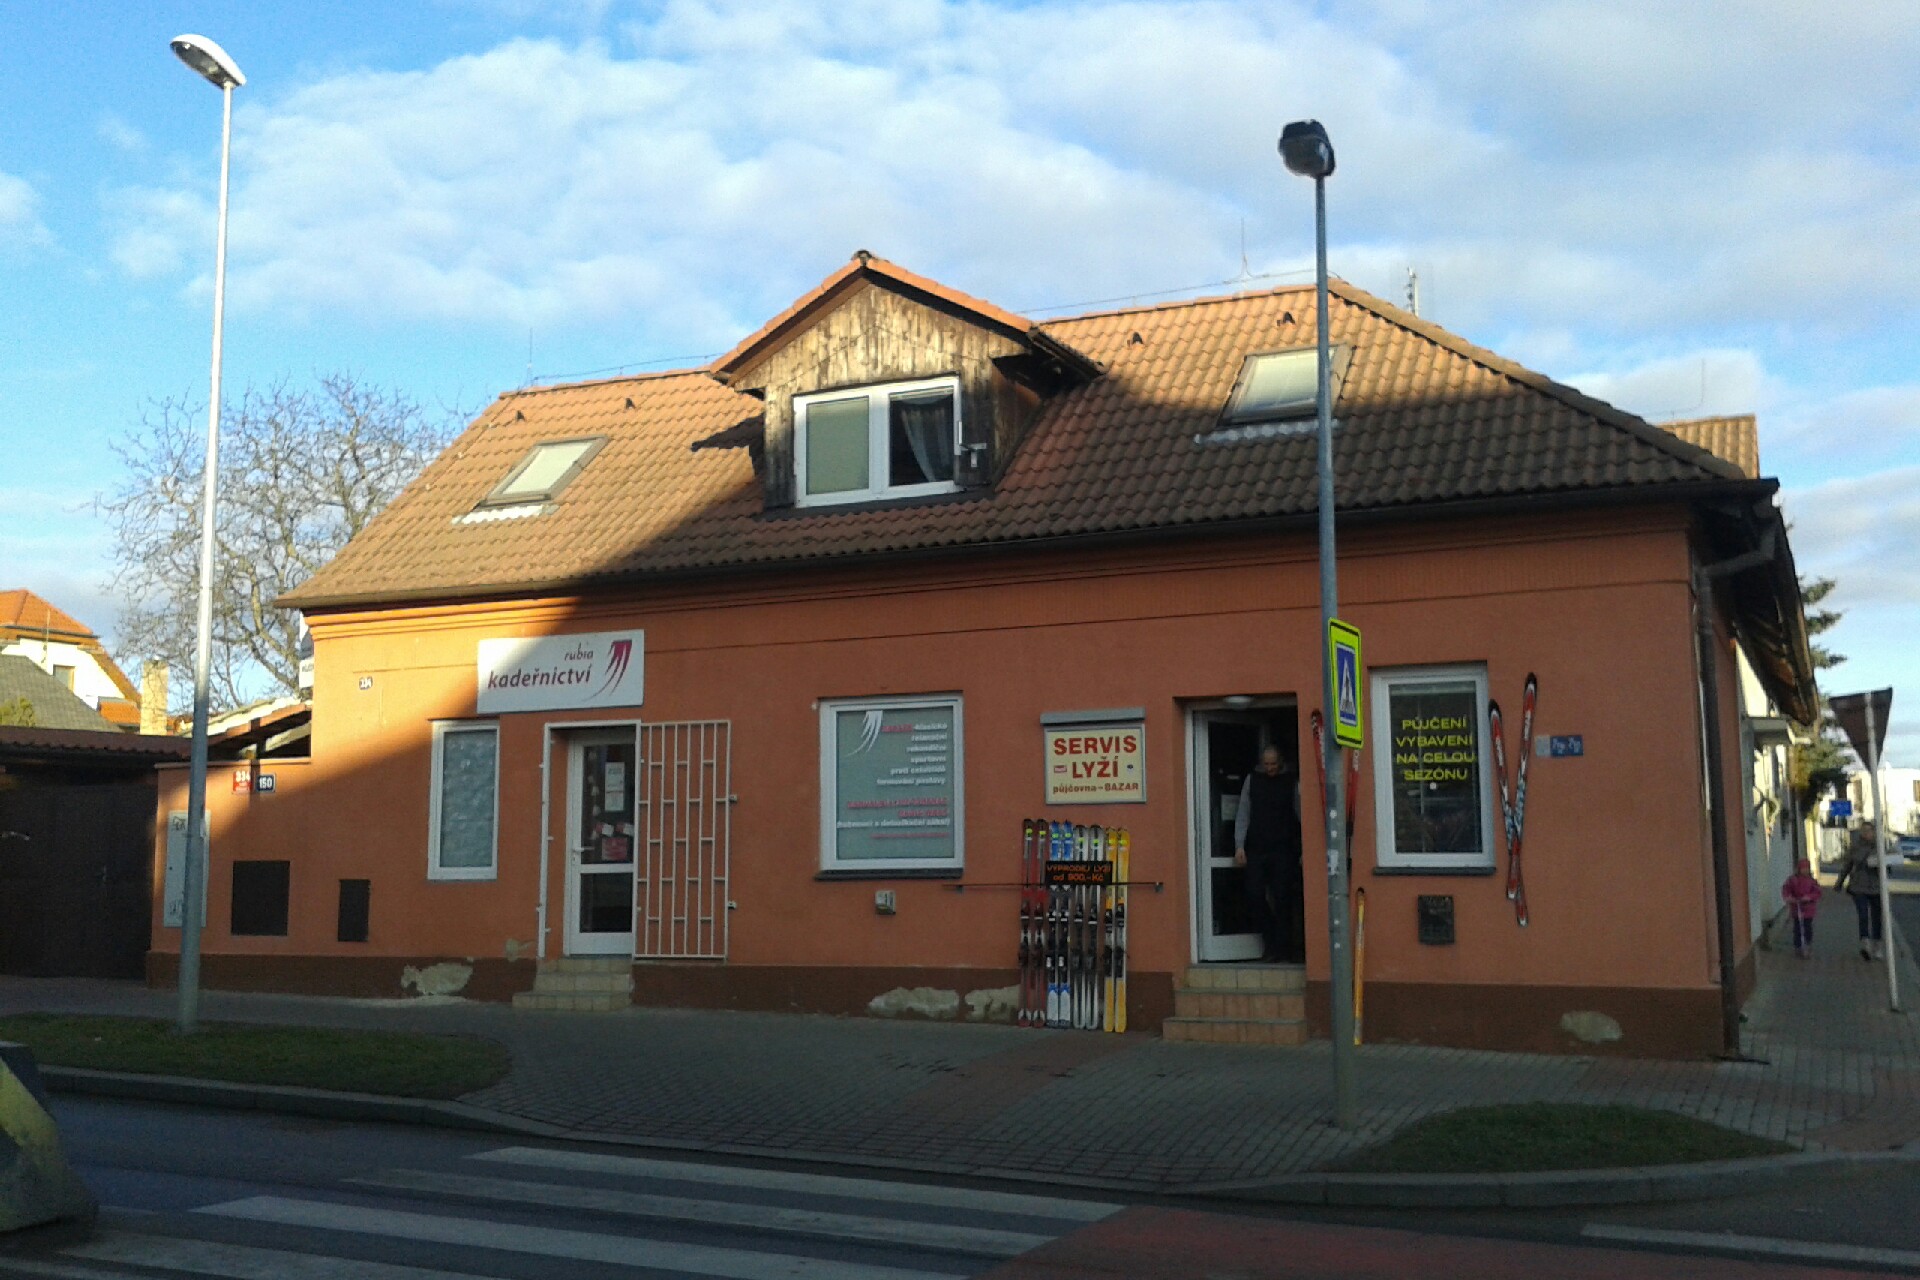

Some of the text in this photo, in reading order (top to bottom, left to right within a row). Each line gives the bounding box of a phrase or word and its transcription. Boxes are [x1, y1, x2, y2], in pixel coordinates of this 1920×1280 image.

[564, 642, 594, 661] rubia
[487, 663, 593, 690] kadeřnictví
[1402, 715, 1467, 730] PŮJČENÍ
[1053, 735, 1137, 755] SERVIS
[1396, 733, 1473, 748] VYBAVENÍ
[1396, 751, 1475, 764] NA CELOU
[1072, 756, 1119, 779] LYŽÍ
[259, 776, 273, 789] 150
